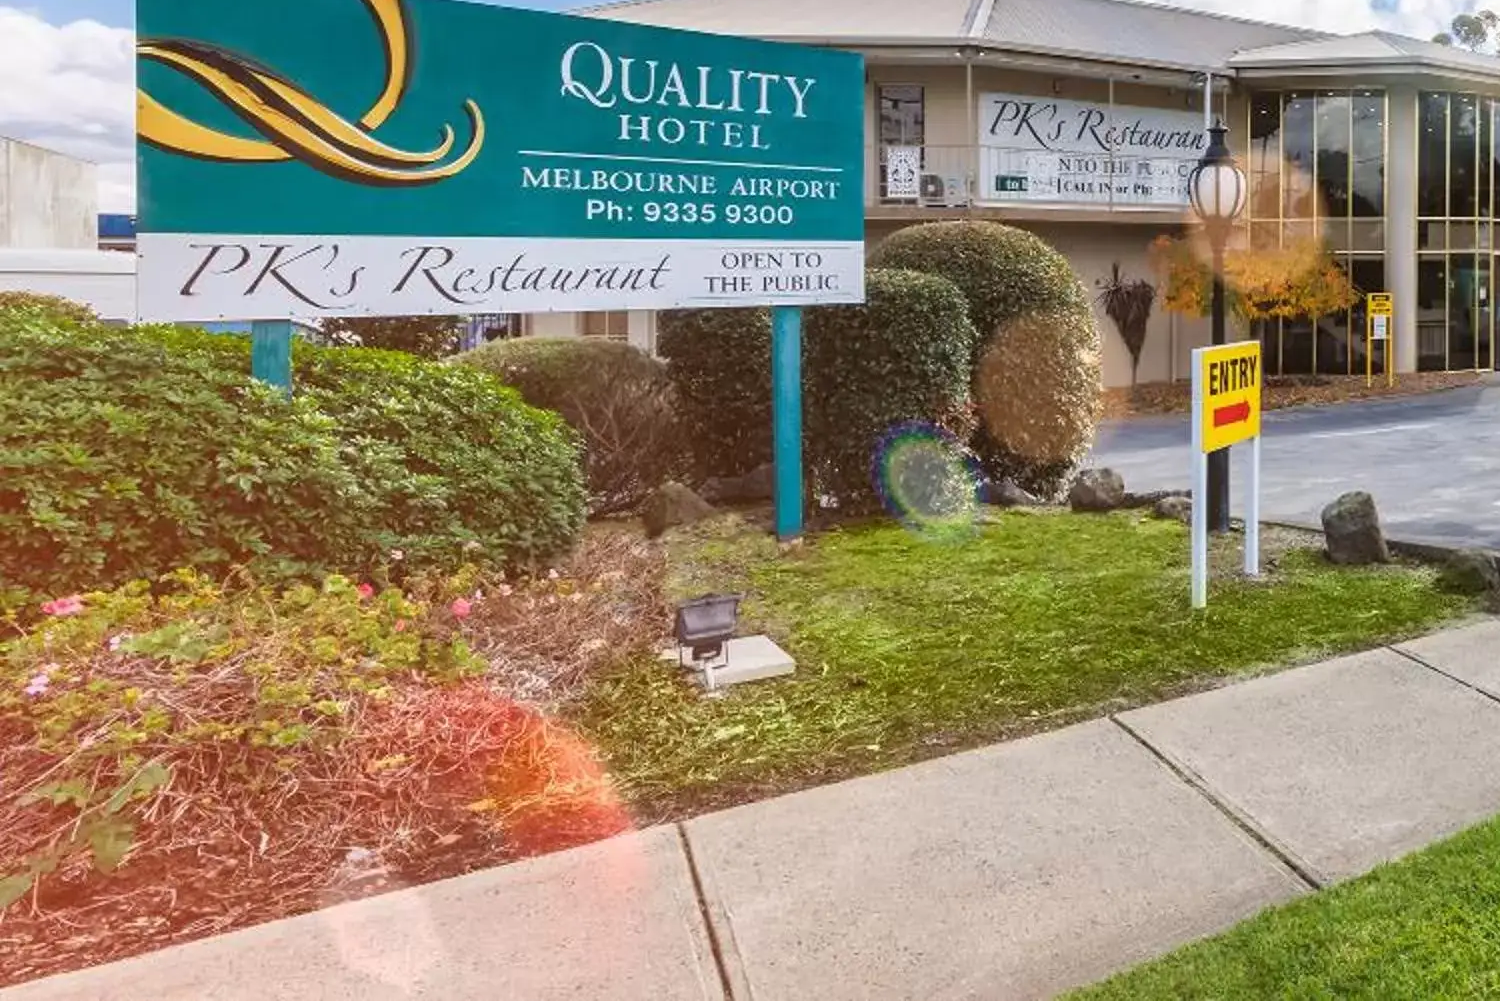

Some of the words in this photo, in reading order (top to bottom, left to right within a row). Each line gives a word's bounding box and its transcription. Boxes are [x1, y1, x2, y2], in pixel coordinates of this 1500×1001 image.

[560, 41, 816, 118] QUALITY
[617, 114, 771, 150] HOTEL
[989, 99, 1066, 150] PK's
[1077, 107, 1205, 152] Restauran
[521, 166, 717, 195] MELBOURNE
[729, 176, 842, 200] AIRPORT
[587, 199, 634, 221] Ph:
[643, 202, 717, 224] 9335
[724, 205, 794, 225] 9300
[179, 244, 366, 310] PK's
[391, 246, 672, 305] Restaurant
[721, 252, 784, 270] OPEN
[790, 252, 823, 269] TO
[703, 276, 754, 293] THE
[762, 274, 840, 293] PUBLIC
[1210, 356, 1257, 395] ENTRY
